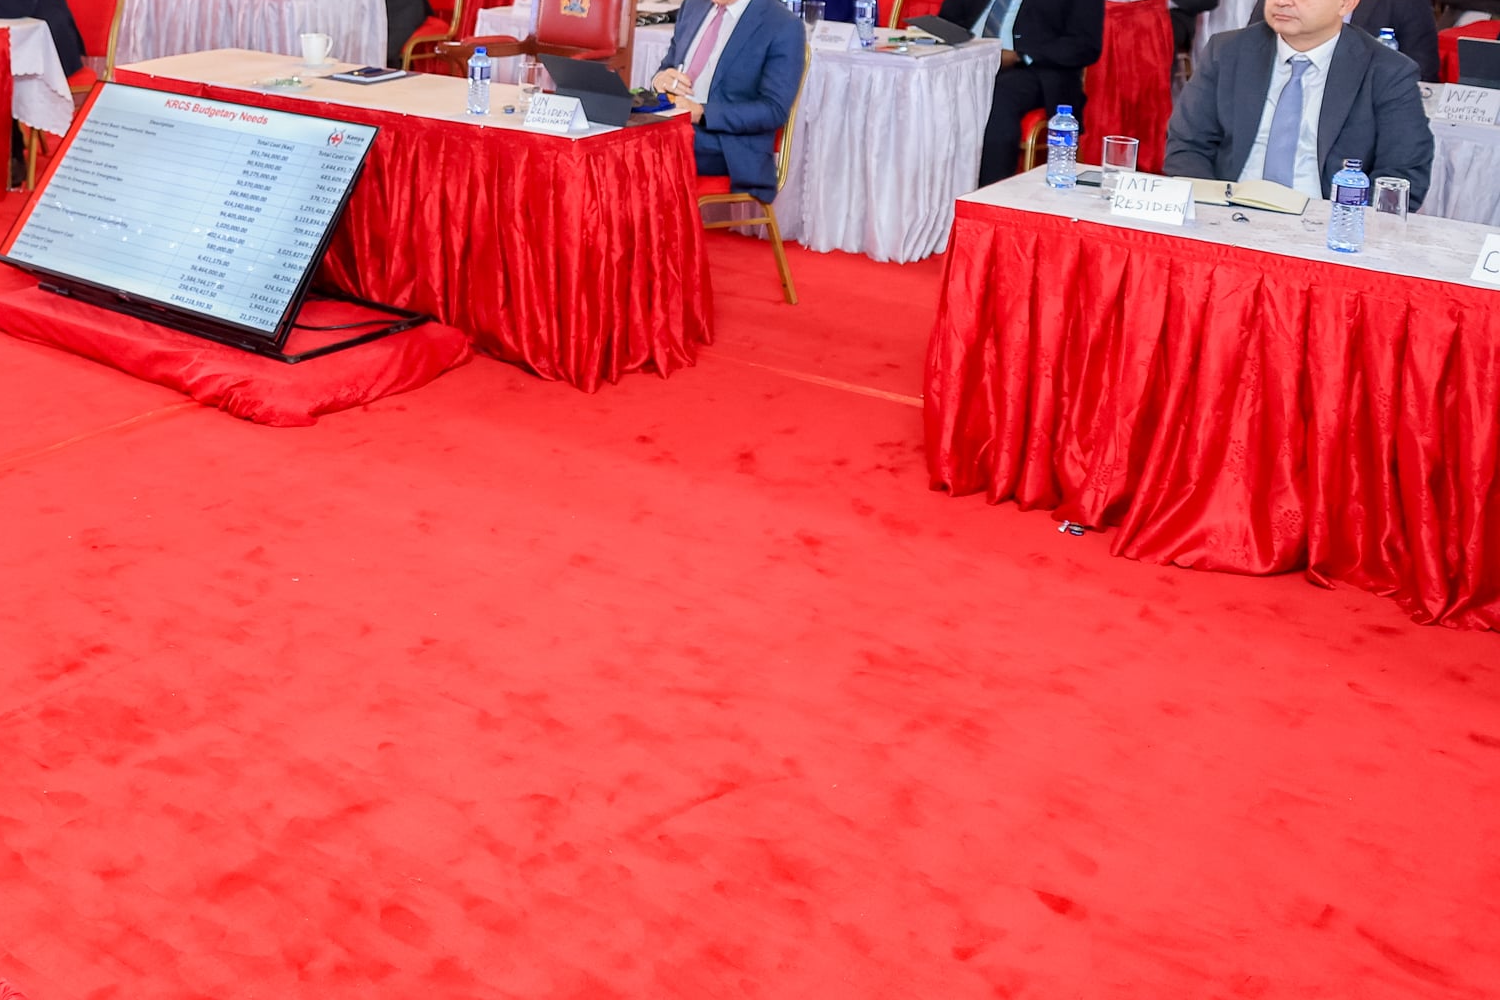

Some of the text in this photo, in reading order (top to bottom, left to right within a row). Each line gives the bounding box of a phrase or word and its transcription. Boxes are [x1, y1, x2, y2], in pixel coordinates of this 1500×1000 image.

[533, 96, 550, 107] UN
[1447, 89, 1489, 104] WFP
[164, 99, 269, 125] KRCS Budgetary Needs
[1119, 175, 1162, 193] IMF
